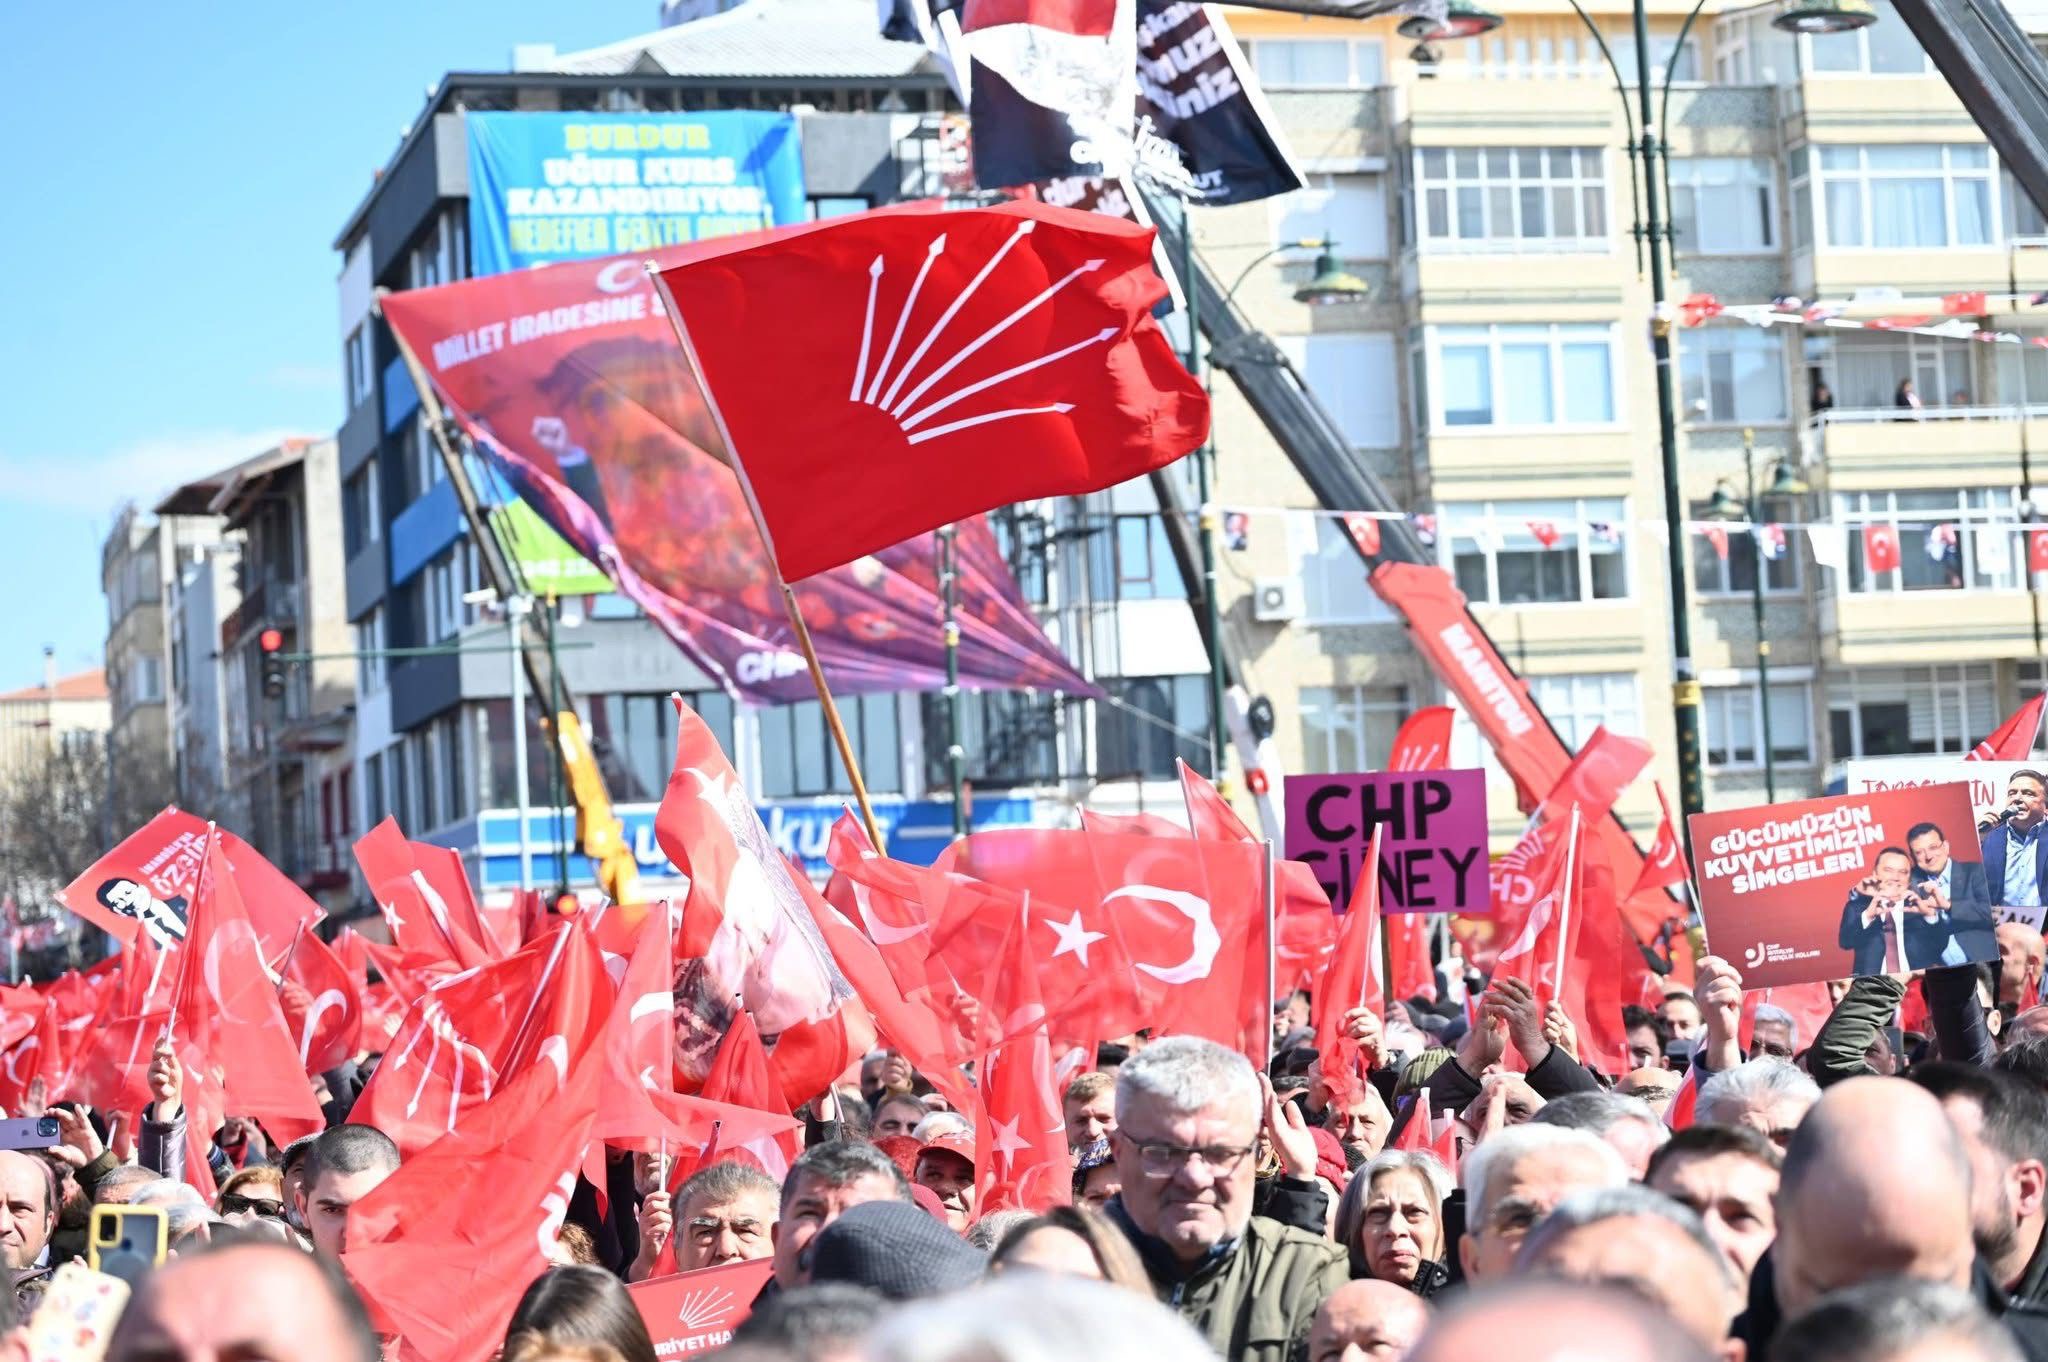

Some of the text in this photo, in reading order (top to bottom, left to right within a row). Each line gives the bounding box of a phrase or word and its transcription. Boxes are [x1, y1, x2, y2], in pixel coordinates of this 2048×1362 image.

[565, 124, 709, 150] BURDUR
[543, 152, 736, 186] UĞUR KURS
[1440, 623, 1534, 737] MANITOU
[1306, 780, 1452, 843] CHP
[1710, 805, 1872, 855] GÜCÜMÜZÜN
[1704, 823, 1885, 879] KUVVETİMİZİN
[1732, 847, 1865, 894] SİMGELERİ
[707, 1329, 735, 1347] HA
